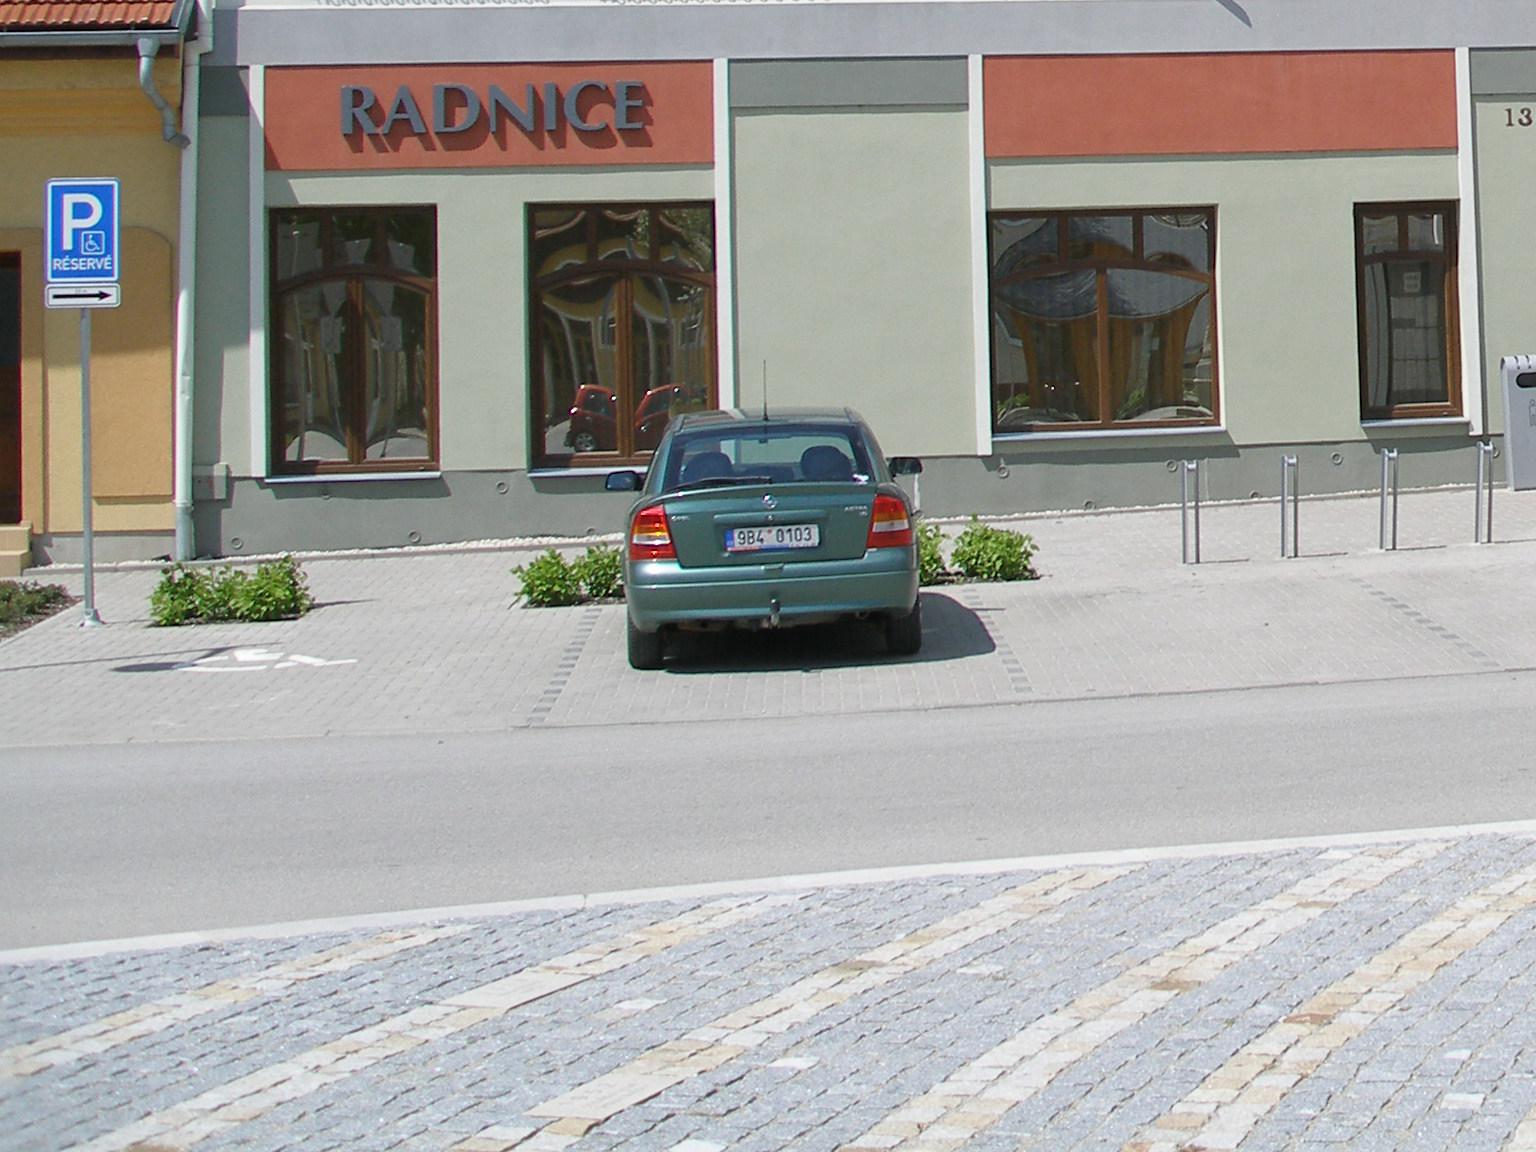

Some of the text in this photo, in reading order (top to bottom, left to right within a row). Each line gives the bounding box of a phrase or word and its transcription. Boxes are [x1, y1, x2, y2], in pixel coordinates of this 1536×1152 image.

[341, 80, 646, 135] RADNICE
[62, 192, 103, 251] P
[52, 254, 113, 271] RÉSERVÉ
[737, 526, 812, 546] 9B4 0103
